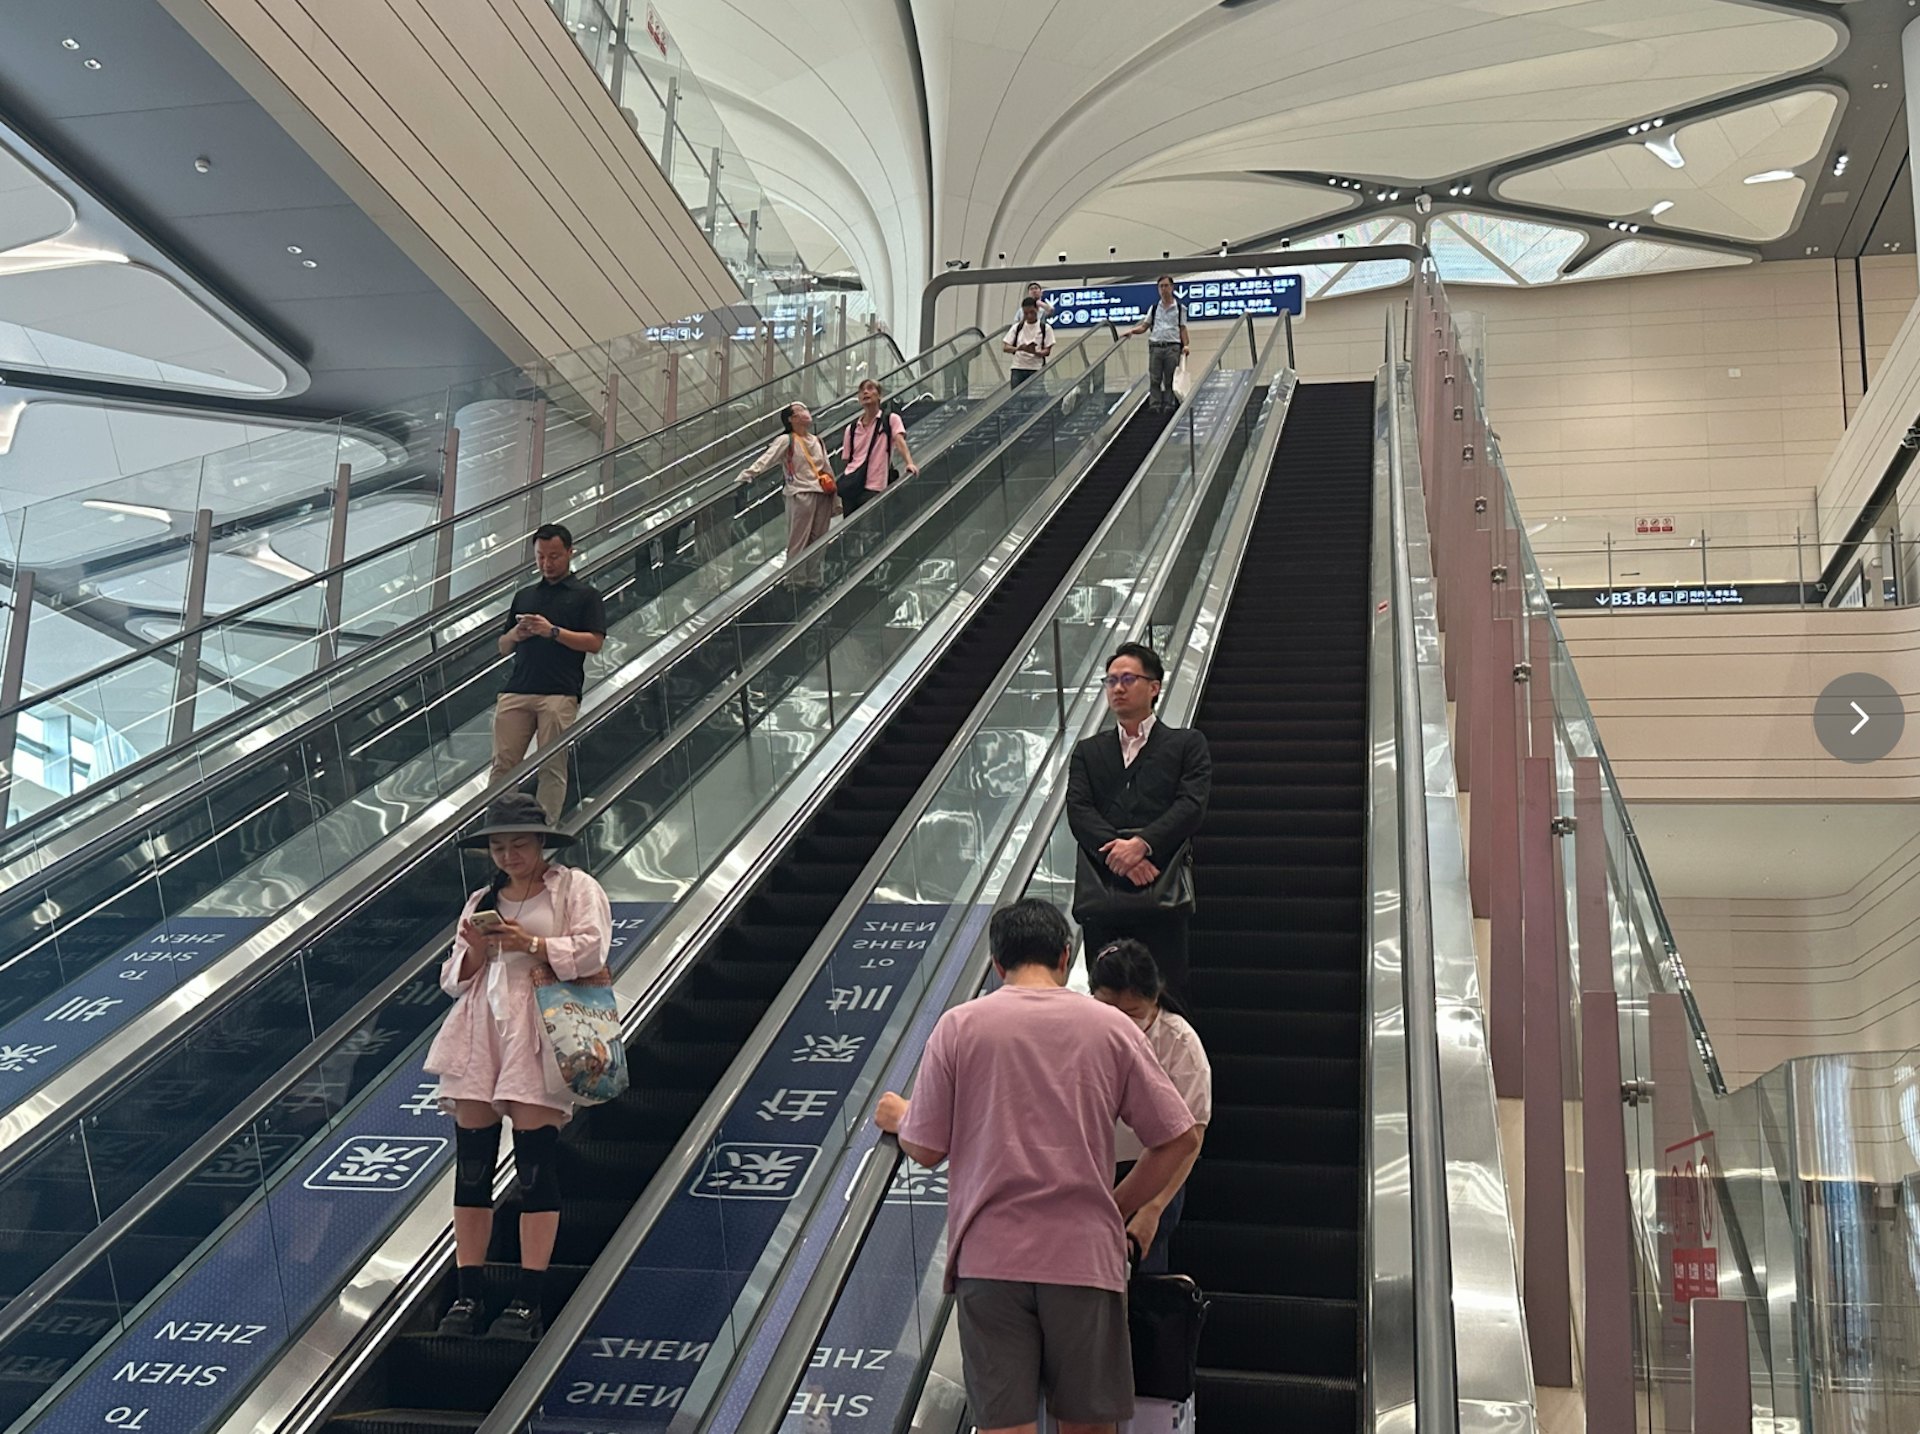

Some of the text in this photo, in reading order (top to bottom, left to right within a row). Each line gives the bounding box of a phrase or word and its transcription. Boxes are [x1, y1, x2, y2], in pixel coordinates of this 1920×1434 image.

[151, 933, 225, 944] ZHEN
[123, 951, 199, 962] SHEN
[563, 1002, 619, 1023] SINGAPOR
[327, 1142, 430, 1183] 深
[154, 1321, 267, 1344] ZHEN
[808, 1347, 893, 1370] ZHE
[112, 1361, 227, 1387] SHEN
[788, 1392, 874, 1418] SHE
